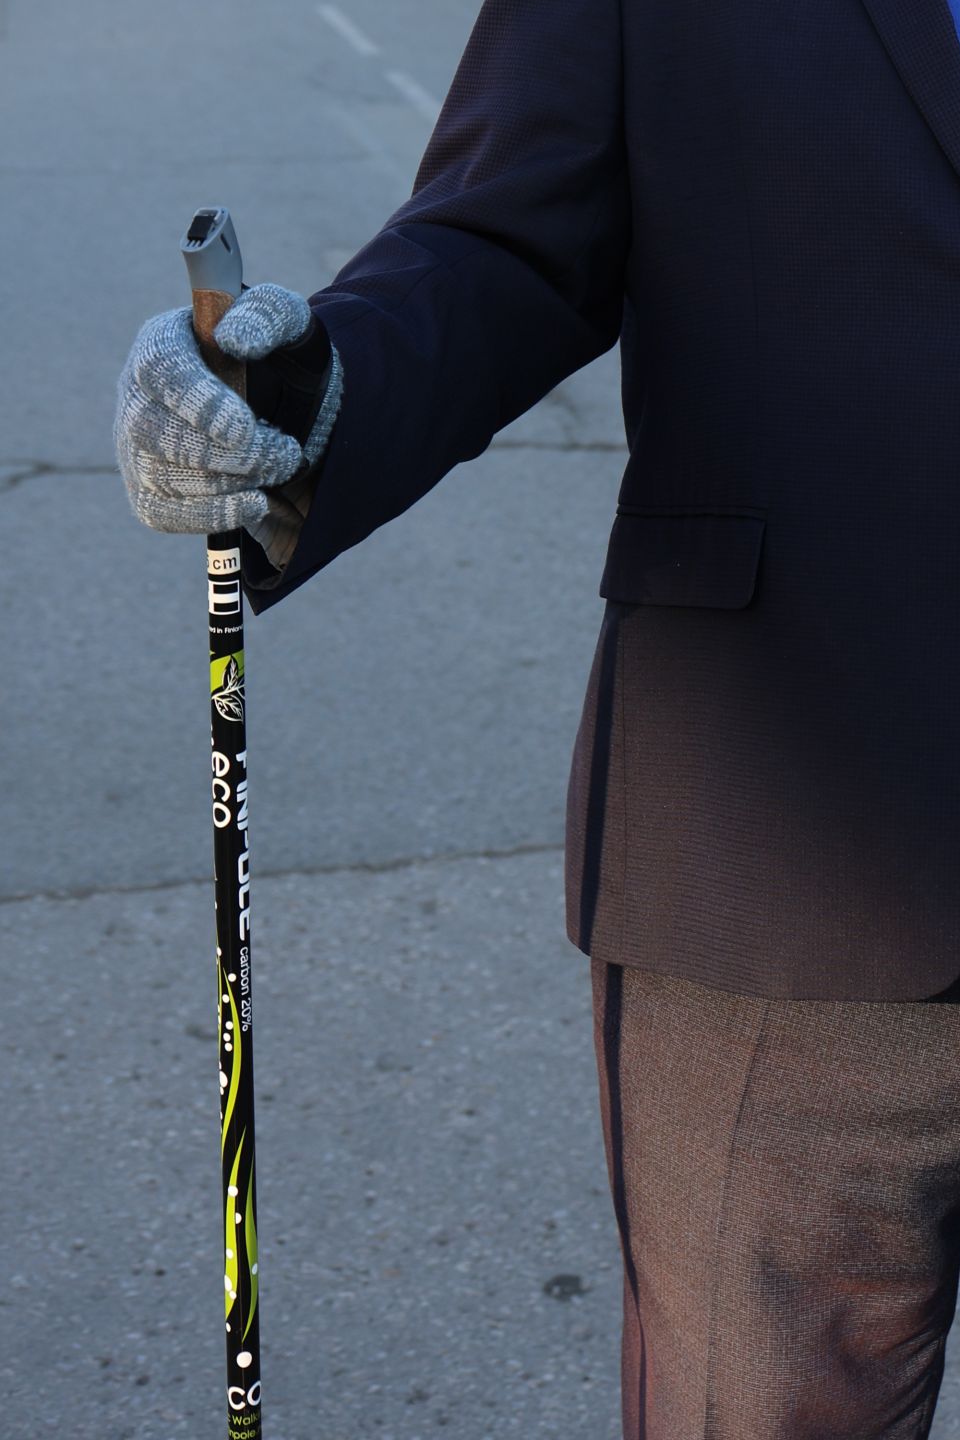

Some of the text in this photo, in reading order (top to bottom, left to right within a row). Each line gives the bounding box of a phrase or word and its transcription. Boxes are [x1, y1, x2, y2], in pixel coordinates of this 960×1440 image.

[212, 557, 237, 570] cm
[224, 625, 243, 634] Finlan
[211, 751, 232, 829] eco
[240, 946, 249, 996] carbon
[241, 997, 252, 1032] 20%
[228, 1380, 261, 1410] co
